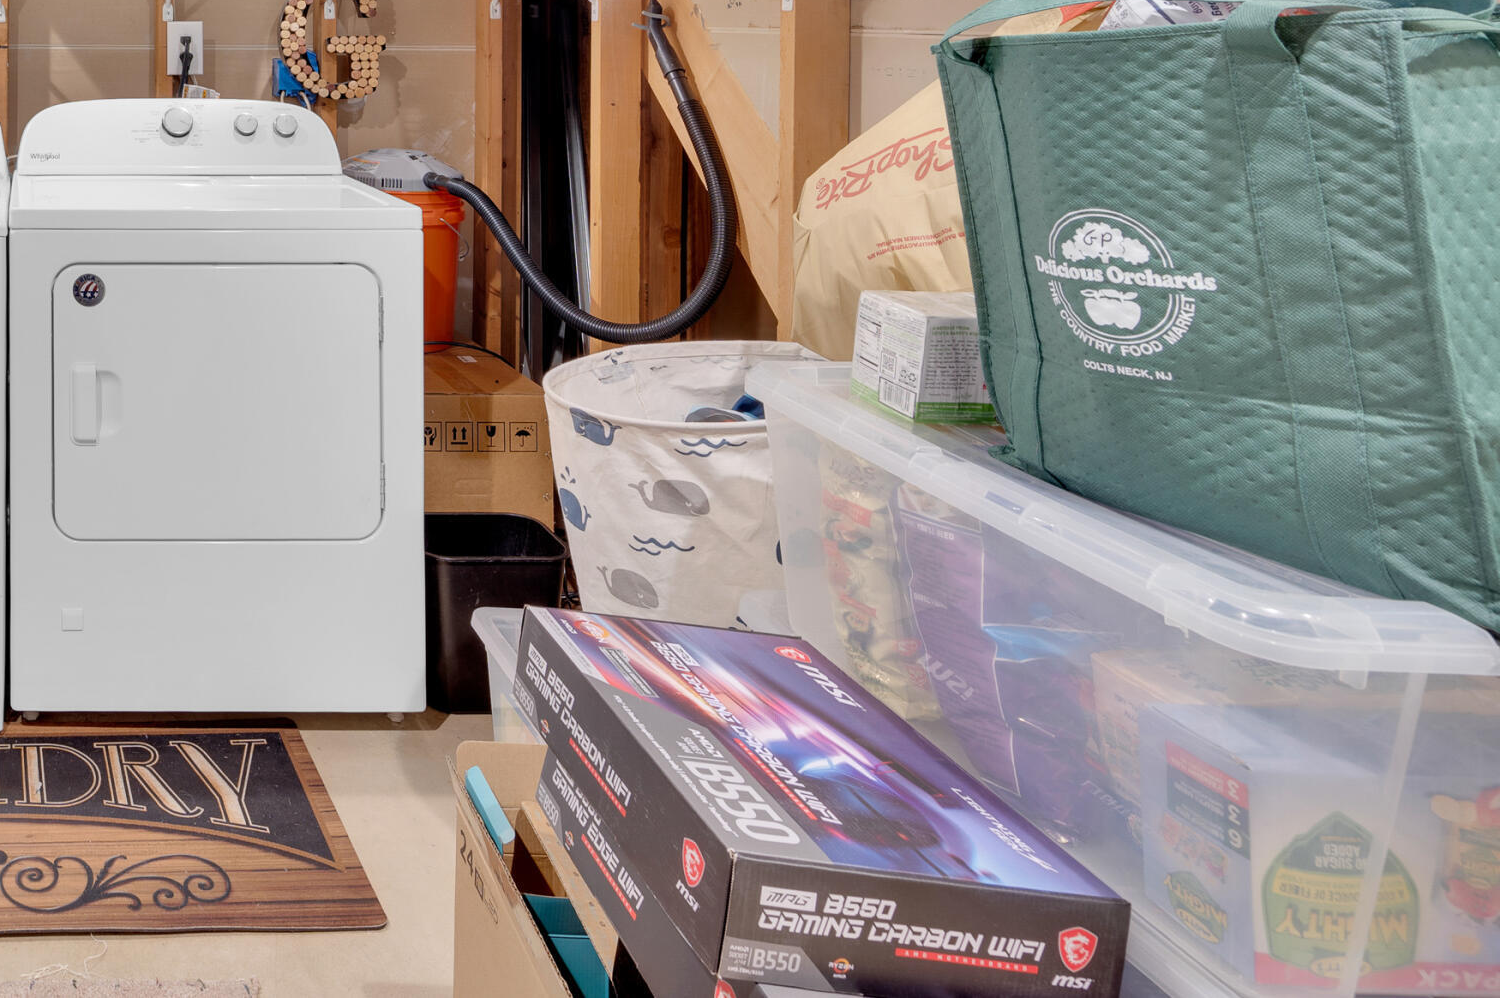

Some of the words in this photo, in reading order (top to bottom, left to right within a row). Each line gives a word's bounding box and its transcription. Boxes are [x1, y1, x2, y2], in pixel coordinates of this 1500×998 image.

[30, 152, 61, 162] Whirlpool
[816, 127, 955, 210] ShopRite
[1034, 254, 1105, 283] Delicious
[1106, 266, 1218, 291] Orchards
[1048, 280, 1061, 307] THE
[1060, 308, 1115, 354] COUNTRY
[1120, 340, 1164, 357] FOOD
[1162, 294, 1196, 345] MARKET
[1083, 359, 1116, 373] COLTS
[1117, 366, 1154, 381] NECK,
[1155, 370, 1173, 382] NJ
[649, 640, 687, 672] B550
[519, 685, 536, 717] B550
[547, 668, 575, 711] B550
[795, 661, 862, 710] msi
[525, 661, 562, 714] GAMING
[560, 709, 607, 772] CARBON
[605, 765, 632, 808] WIFI
[680, 671, 740, 724] GAMING
[730, 723, 805, 789] CARBON
[795, 787, 843, 826] WIFI
[682, 759, 801, 845] B550
[950, 787, 1037, 854] LIGHTNING
[552, 768, 589, 828] GAMING
[587, 823, 621, 873] EDGE
[617, 866, 645, 911] WIFI
[1323, 843, 1360, 856] ADDED
[675, 880, 701, 914] msi
[765, 890, 812, 908] MPG
[1163, 872, 1229, 931] MIGHTY
[1278, 881, 1308, 897] FIBER
[822, 894, 897, 920] B550
[757, 909, 866, 940] GAMING
[867, 921, 983, 953] CARBON
[987, 935, 1047, 963] WIFI
[753, 947, 802, 974] B550
[828, 962, 855, 971] RYZEN
[904, 949, 930, 960] AMD
[936, 952, 1029, 974] MOTHERBOARD
[1051, 973, 1093, 991] msi
